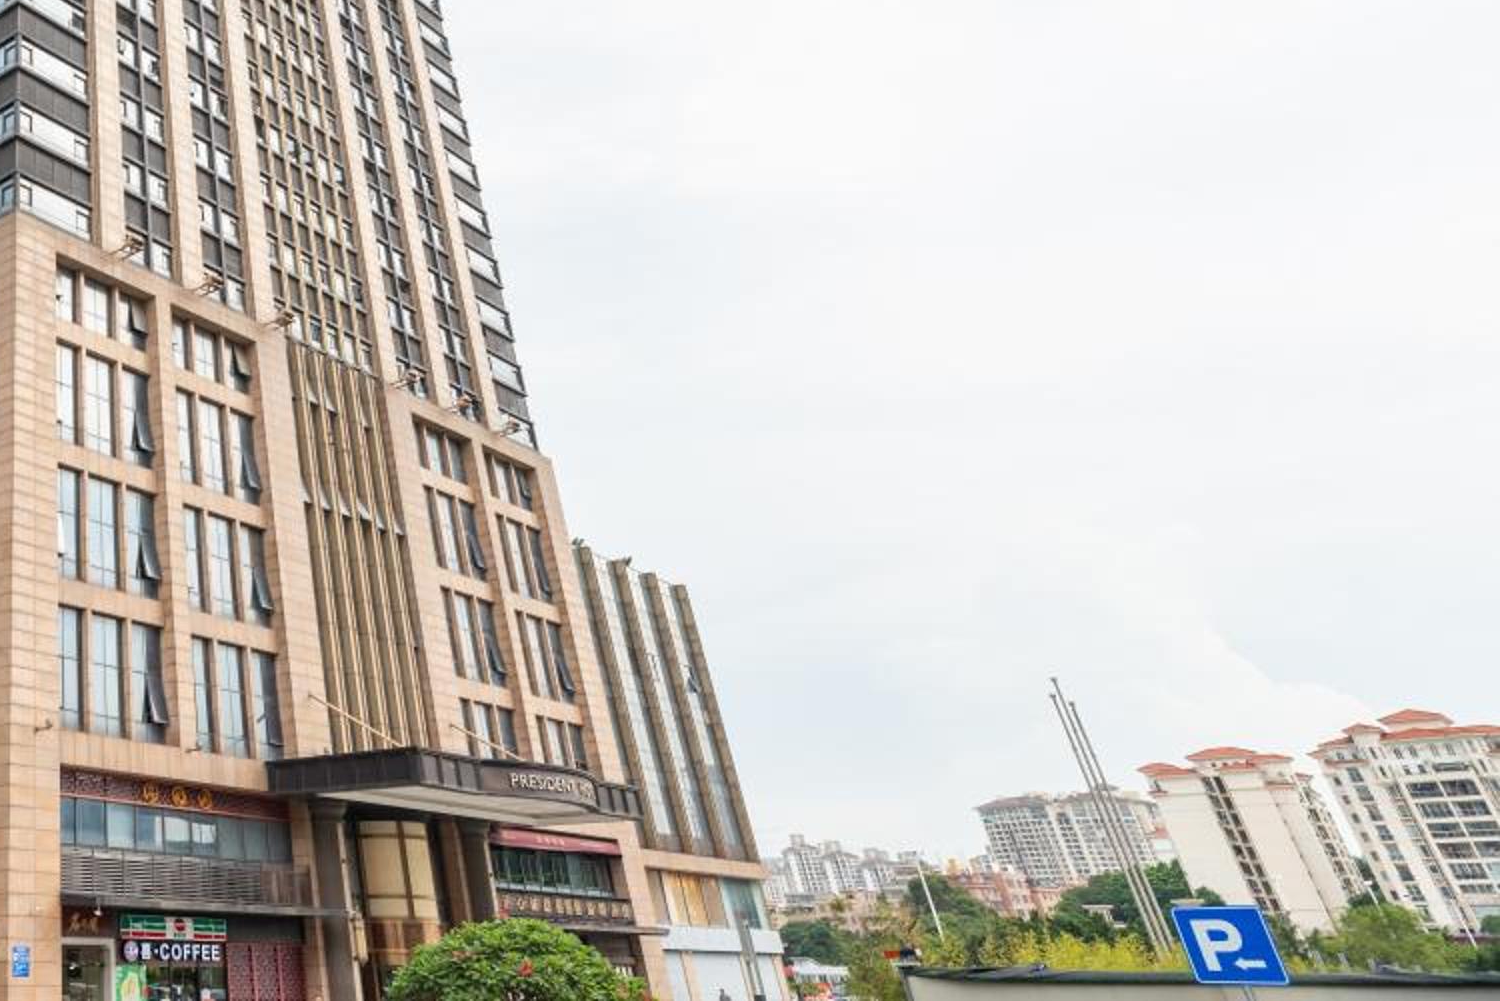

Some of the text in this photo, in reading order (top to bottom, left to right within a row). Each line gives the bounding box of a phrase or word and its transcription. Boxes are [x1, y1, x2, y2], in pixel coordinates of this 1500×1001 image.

[510, 773, 580, 793] PRESIDENT
[160, 943, 220, 961] COFFEE
[1190, 919, 1243, 972] P
